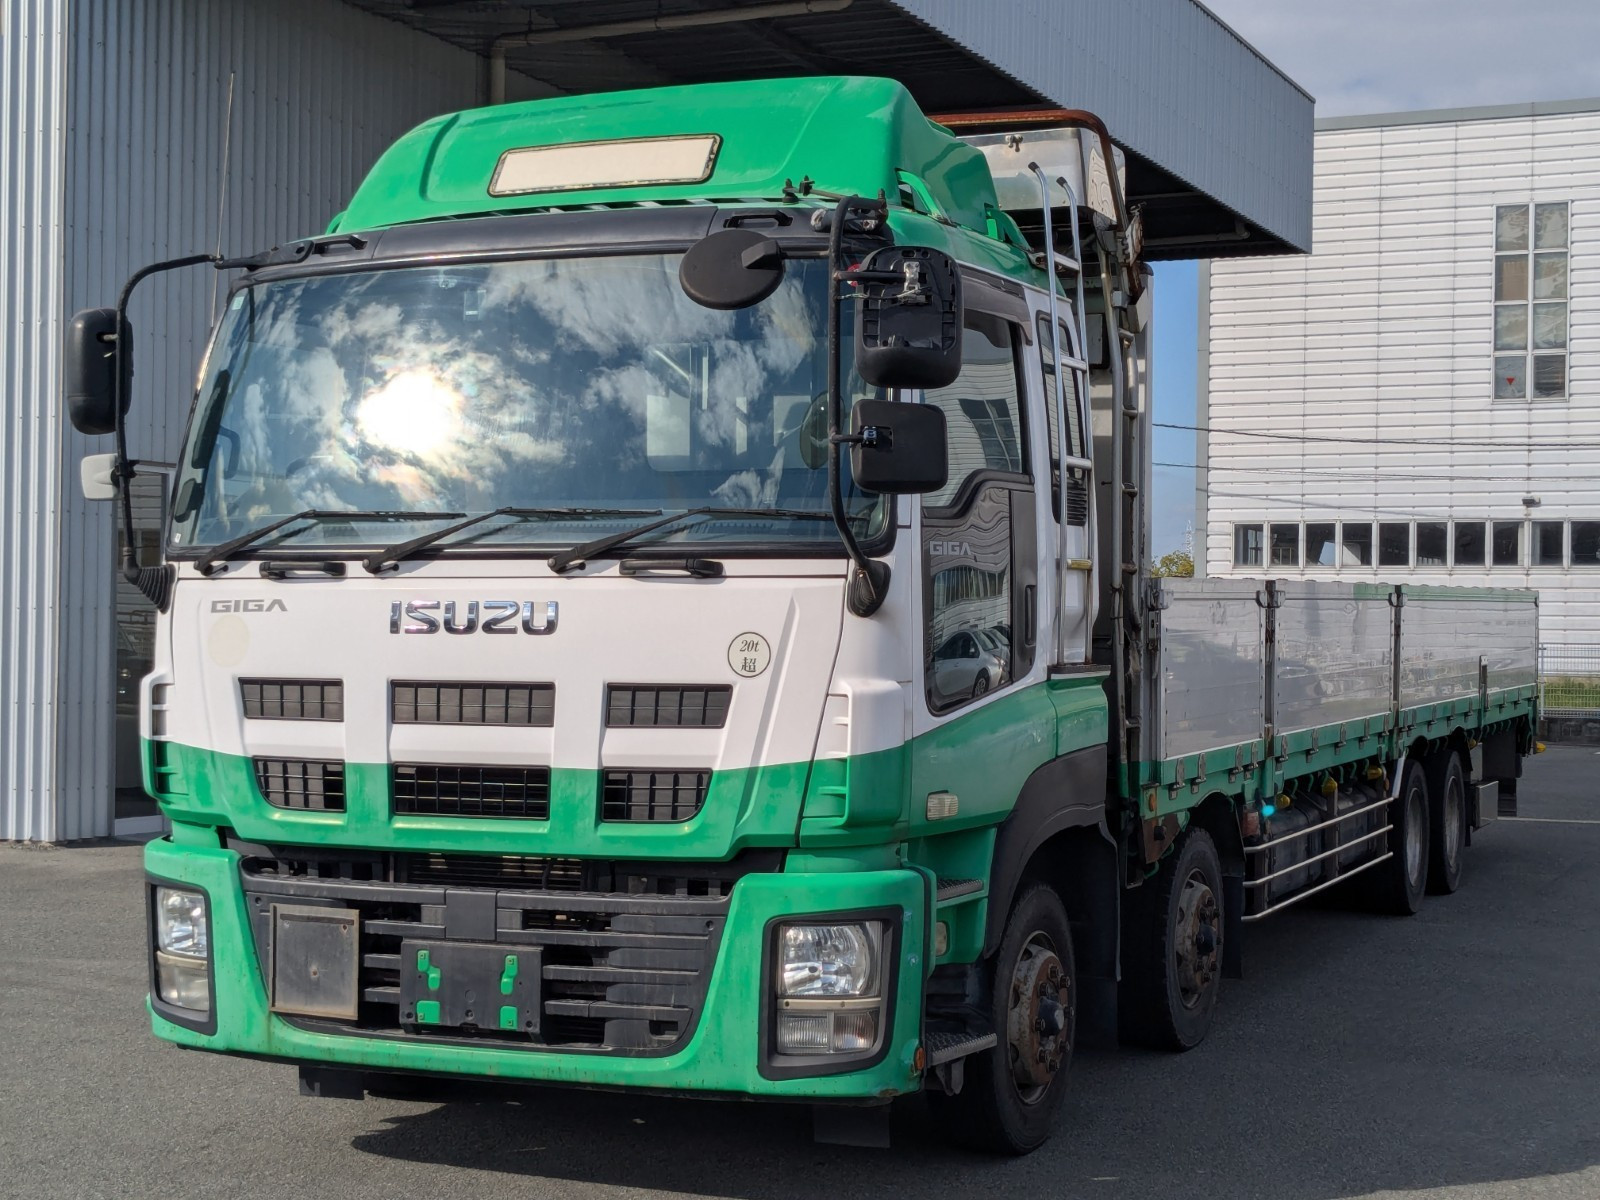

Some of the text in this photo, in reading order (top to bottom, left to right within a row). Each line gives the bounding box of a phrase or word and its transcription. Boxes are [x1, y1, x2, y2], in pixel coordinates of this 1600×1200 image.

[930, 541, 971, 556] GIGA
[211, 599, 288, 613] GIGA
[389, 600, 559, 635] ISUZU
[739, 639, 760, 653] 20t
[740, 656, 757, 673] 超
